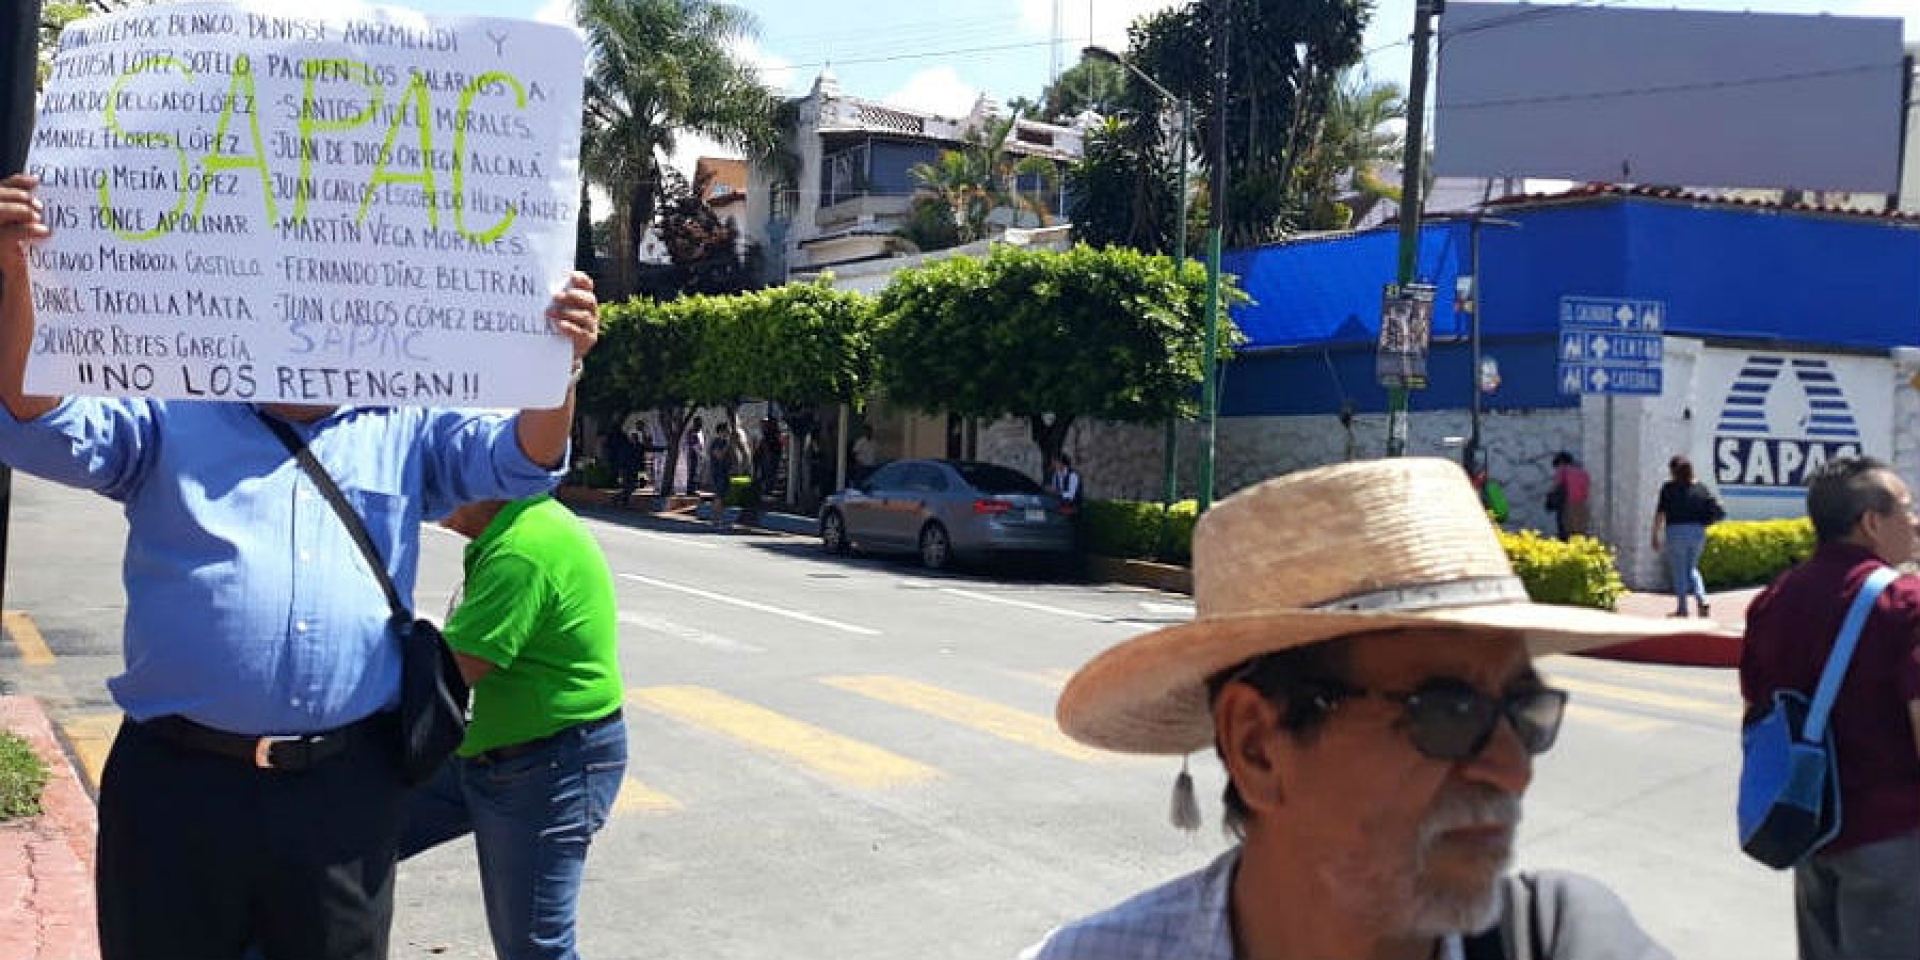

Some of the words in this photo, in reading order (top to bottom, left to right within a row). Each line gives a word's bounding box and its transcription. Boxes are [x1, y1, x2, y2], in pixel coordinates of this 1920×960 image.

[248, 13, 325, 40] DENISSE
[343, 19, 458, 53] ARIZMENDI
[487, 29, 508, 57] Y
[184, 50, 250, 76] SOTELO
[364, 61, 398, 87] LOS
[408, 65, 505, 98] SALARIOS
[116, 91, 194, 112] DELGADO
[200, 88, 254, 114] LÓPEZ
[35, 127, 100, 149] MANUEL
[177, 126, 239, 154] LÓPEZ
[100, 52, 528, 243] SAPAC
[325, 140, 345, 165] DE
[353, 140, 394, 166] DIOS
[399, 145, 462, 171] ORTEGA
[173, 166, 238, 195] LÓPEZ
[322, 178, 380, 205] CARLOS
[90, 205, 147, 231] PONCE
[369, 213, 417, 248] VEGA
[30, 244, 94, 271] OCTAVIO
[99, 244, 177, 273] MENDOZA
[382, 259, 427, 289] DÍAZ
[90, 287, 180, 317] TAFOLLA
[331, 299, 398, 327] CARLOS
[404, 299, 465, 330] GÓMEZ
[111, 324, 168, 356] REYES
[289, 318, 430, 362] SAPAC
[182, 363, 258, 398] LOS
